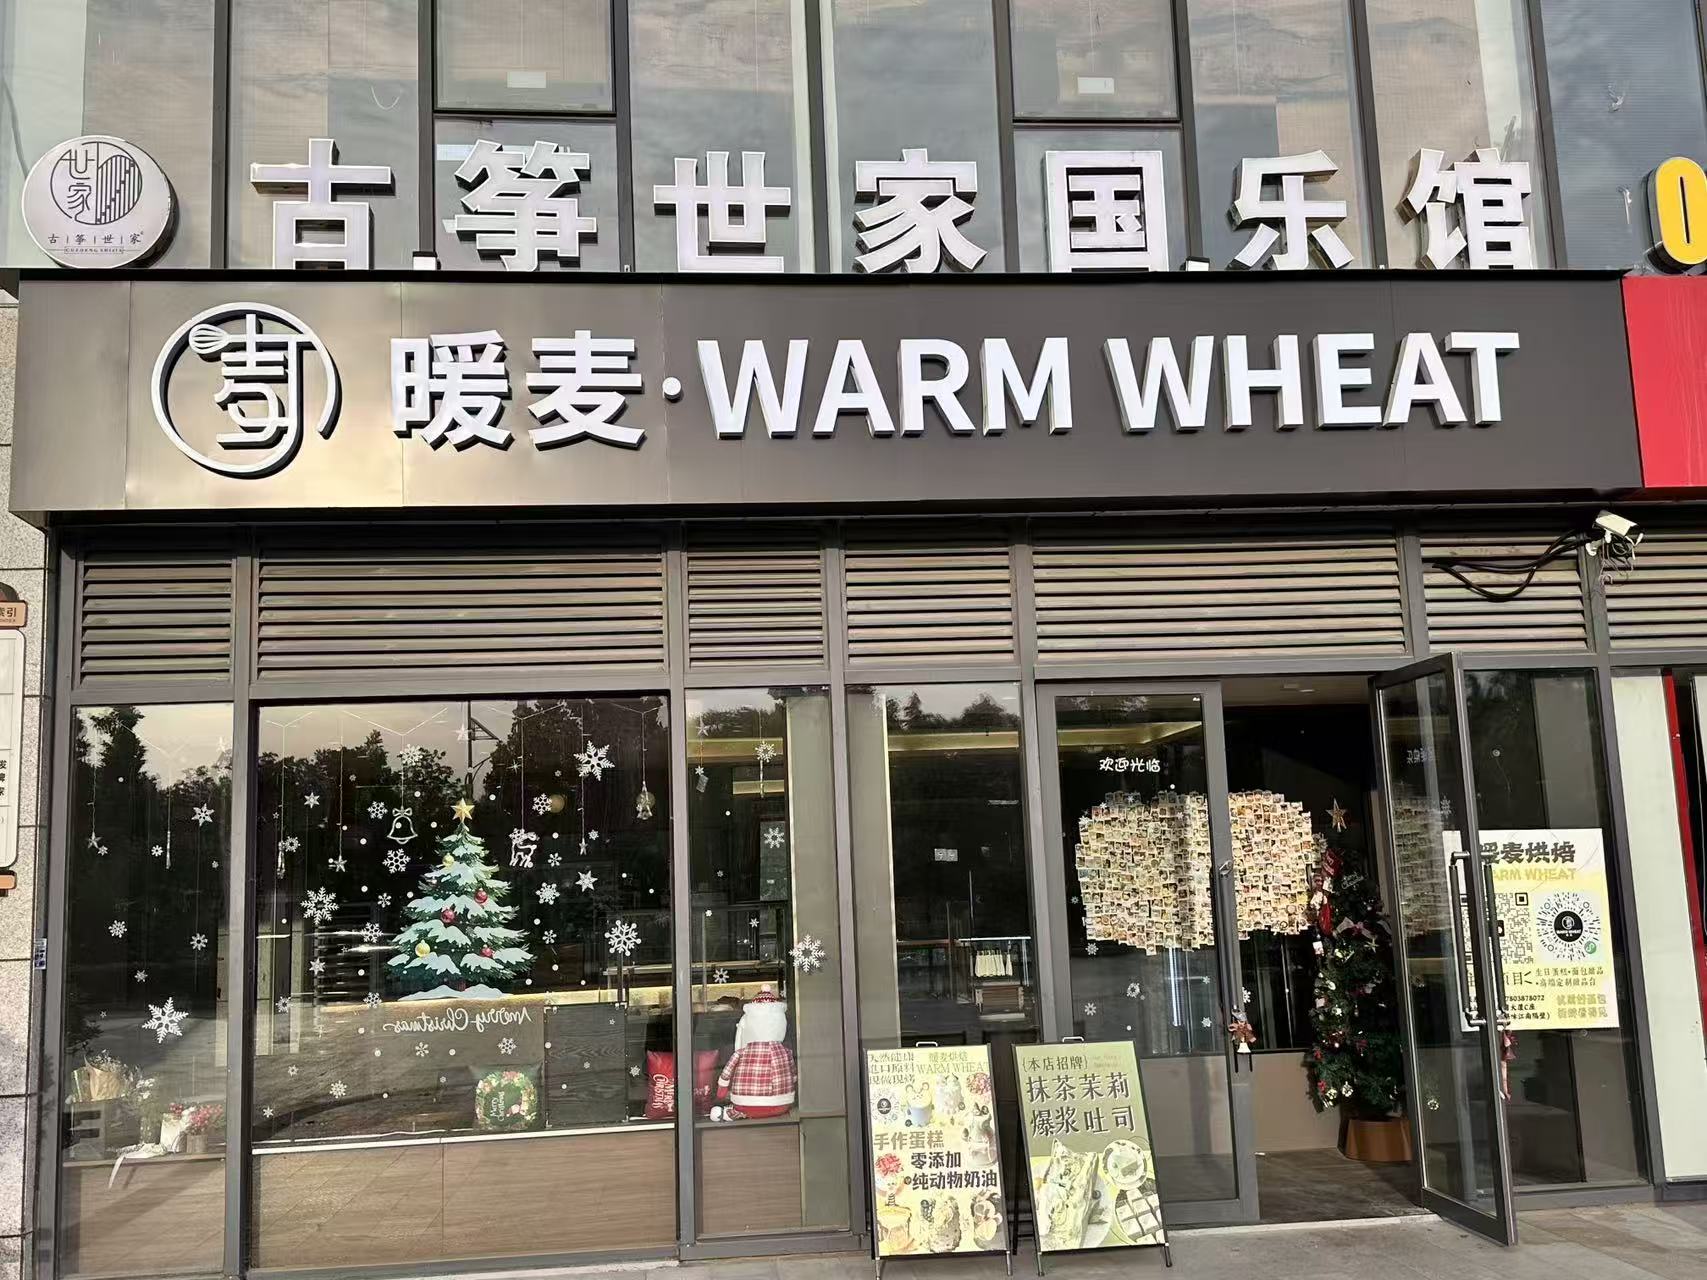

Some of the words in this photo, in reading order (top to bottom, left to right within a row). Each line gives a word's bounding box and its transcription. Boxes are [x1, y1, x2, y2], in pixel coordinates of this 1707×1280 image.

[250, 138, 1534, 273] 古筝世家国乐馆
[697, 337, 1074, 440] WARM
[1103, 331, 1521, 433] WHEAT
[1099, 756, 1161, 772] 欢迎光临
[1525, 867, 1576, 881] WHEAT
[916, 1063, 950, 1074] WARM
[1026, 1072, 1130, 1103] 抹茶茉莉
[1031, 1105, 1135, 1137] 爆浆吐司
[874, 1130, 944, 1151] 手作蛋糕
[911, 1151, 961, 1169] 零添加
[912, 1170, 998, 1190] 纯动物奶油
